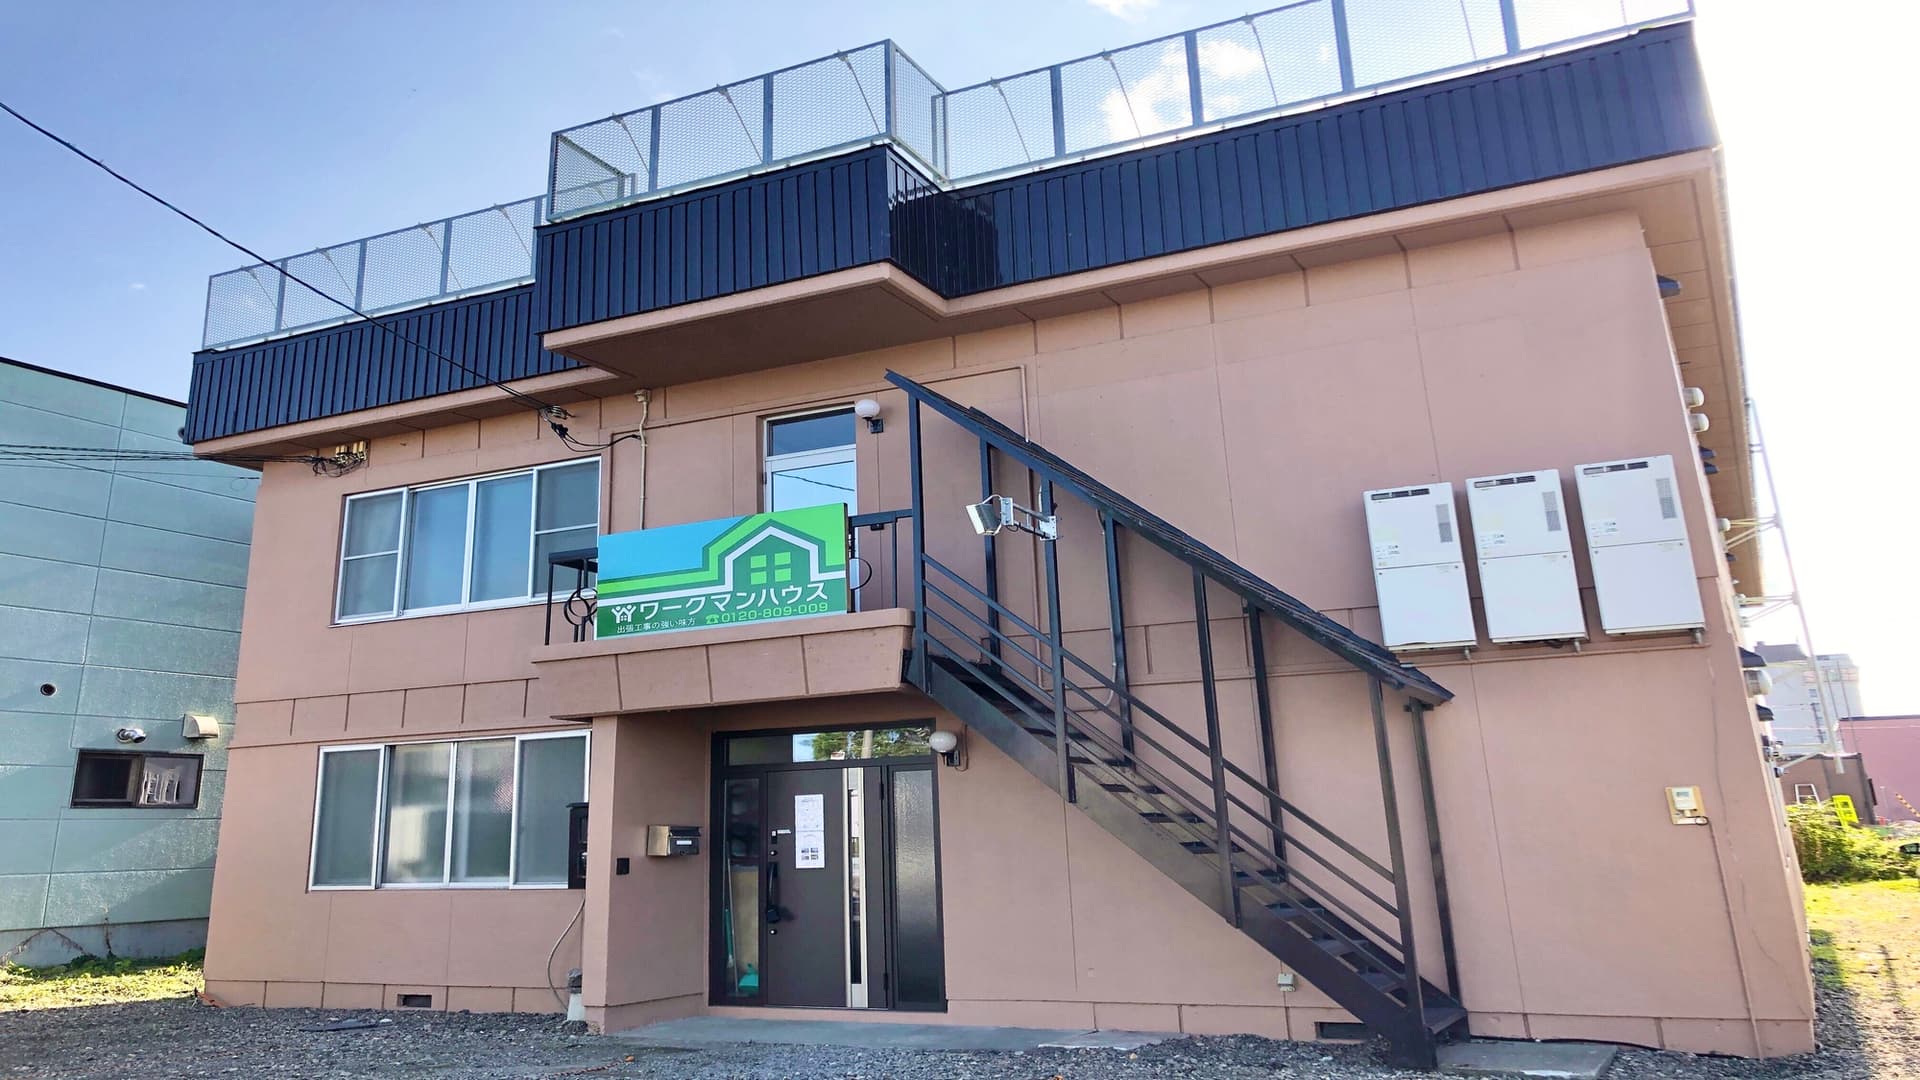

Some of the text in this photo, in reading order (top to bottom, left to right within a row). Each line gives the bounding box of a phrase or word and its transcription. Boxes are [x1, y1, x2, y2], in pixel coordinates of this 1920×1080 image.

[639, 582, 828, 620] ワークマンハウス
[721, 602, 828, 623] 0120-809-009
[616, 617, 696, 634] 出張工事の強い味方
